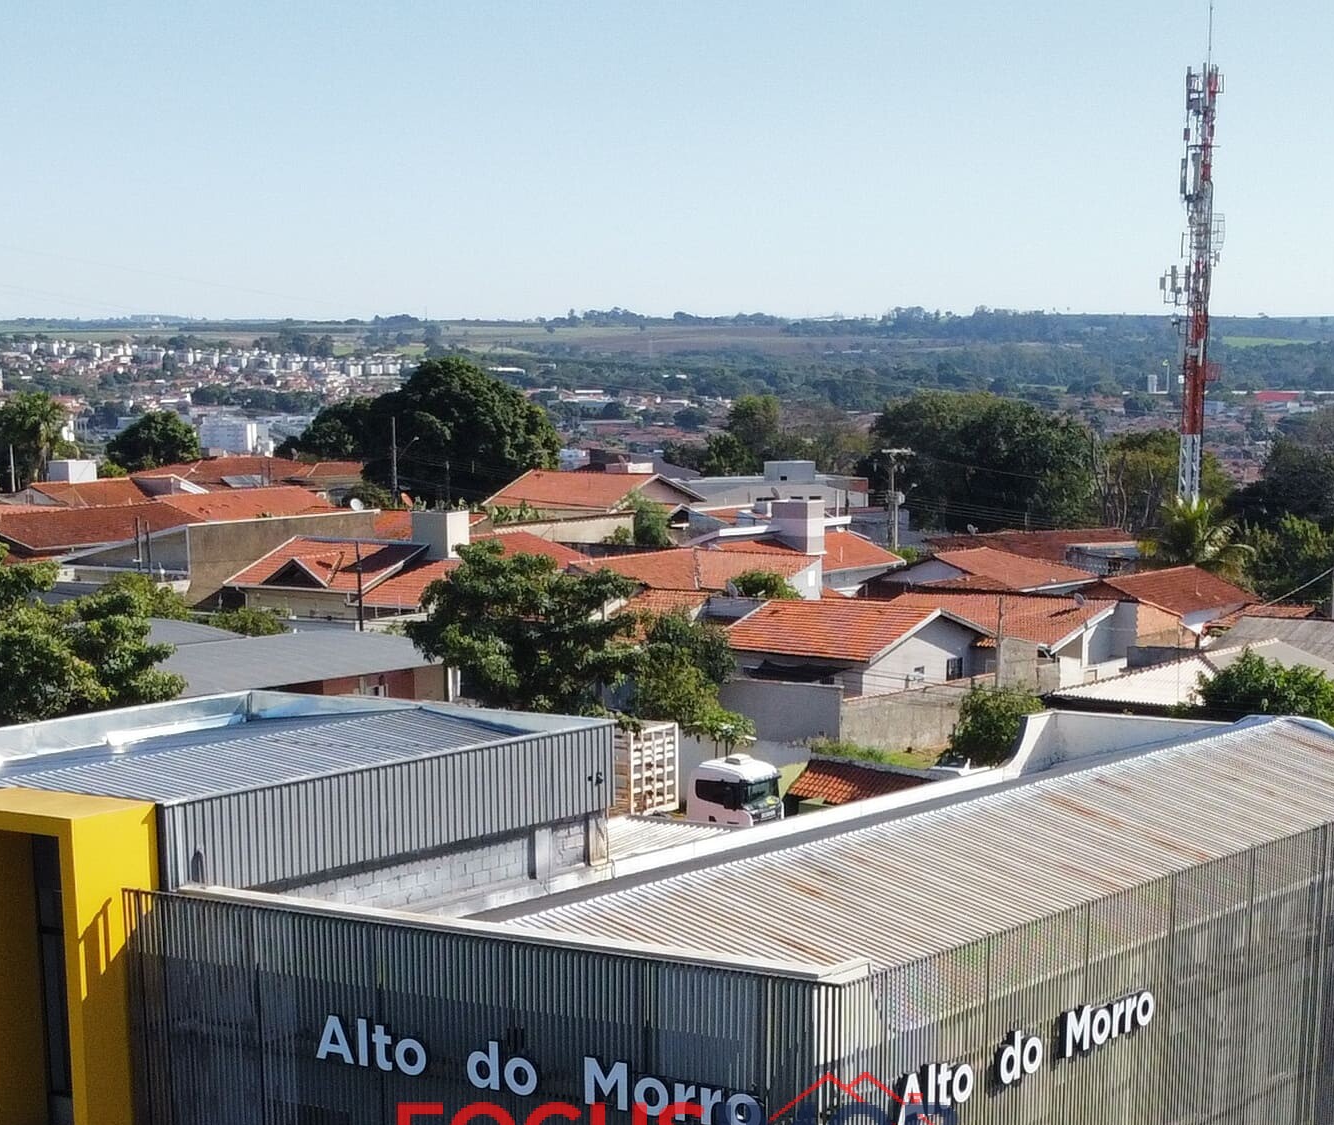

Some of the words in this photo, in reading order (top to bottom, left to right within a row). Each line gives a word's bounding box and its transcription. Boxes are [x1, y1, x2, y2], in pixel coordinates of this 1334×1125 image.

[315, 1013, 428, 1077] Alto
[466, 1040, 539, 1097] do
[999, 1029, 1044, 1085] do
[1065, 989, 1156, 1058] Morro
